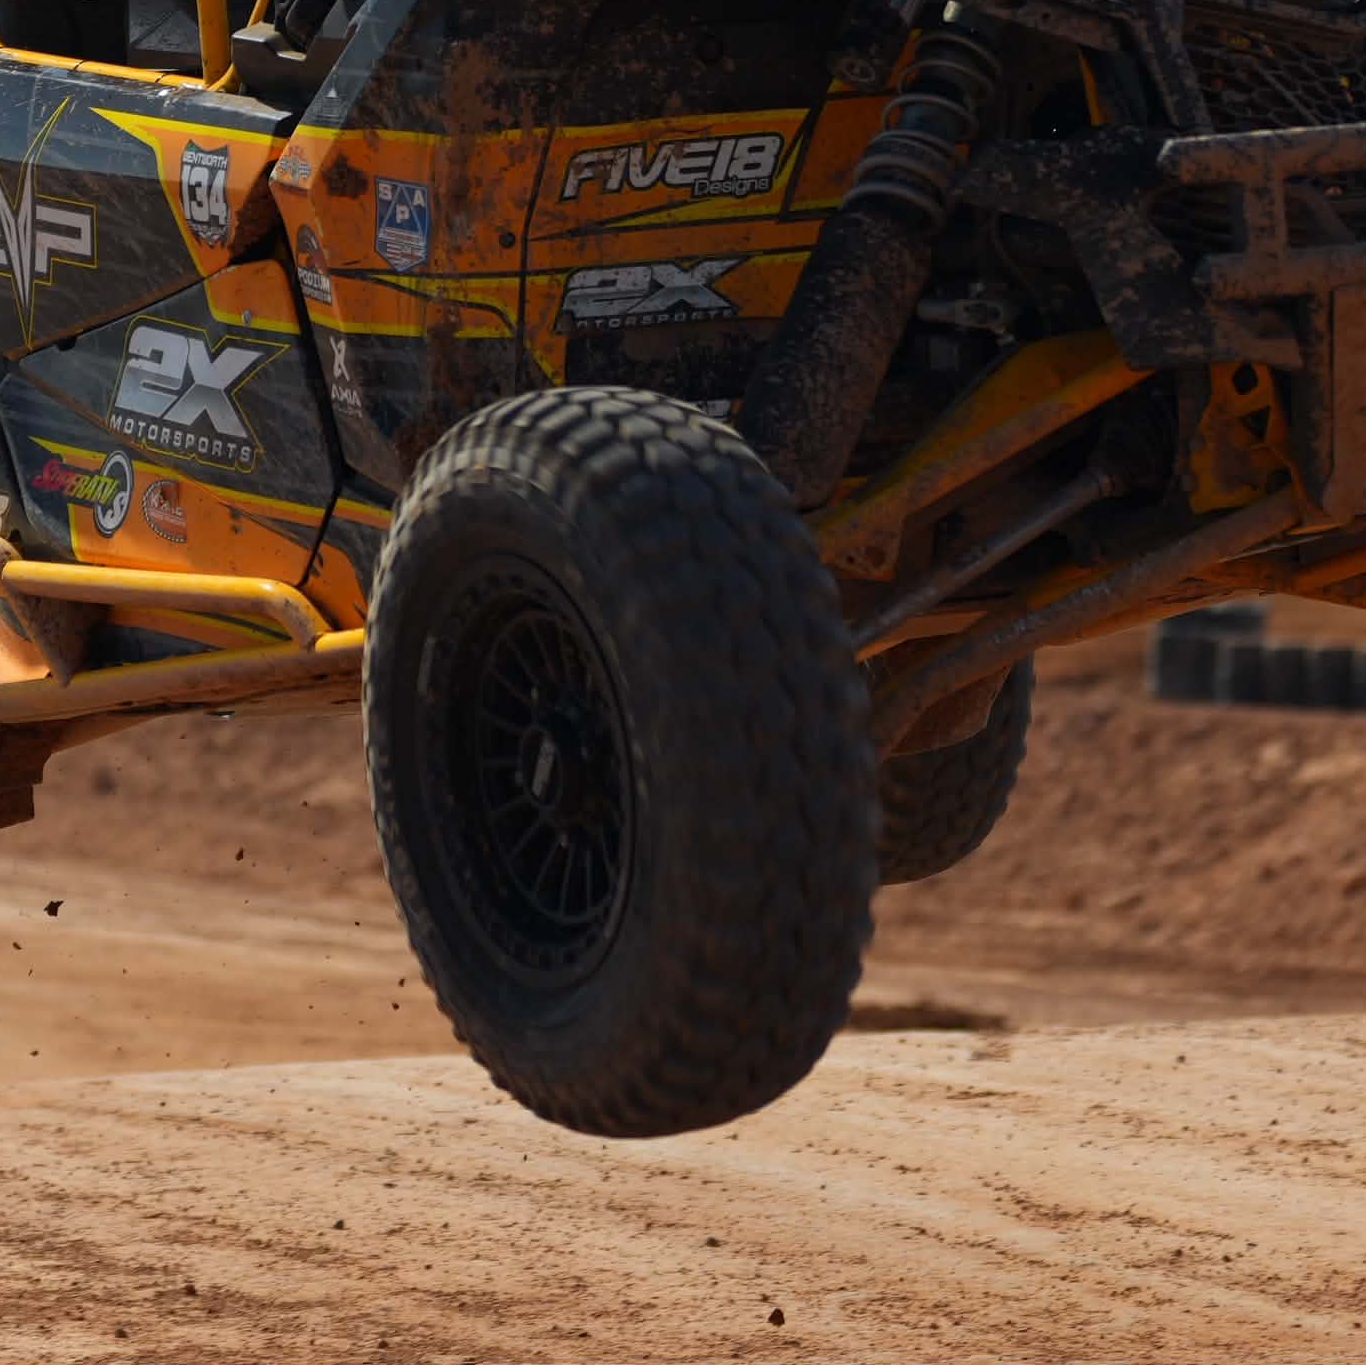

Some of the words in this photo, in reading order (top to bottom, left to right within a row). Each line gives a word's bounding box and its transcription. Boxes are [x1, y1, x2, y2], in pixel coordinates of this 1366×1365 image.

[181, 164, 229, 226] 134
[562, 134, 783, 199] FIVE18
[695, 178, 769, 197] Designs
[562, 259, 747, 319] 2X
[556, 308, 734, 332] OTORSPORTS
[113, 325, 267, 440] 2X
[109, 414, 253, 463] MOTORSPORTS
